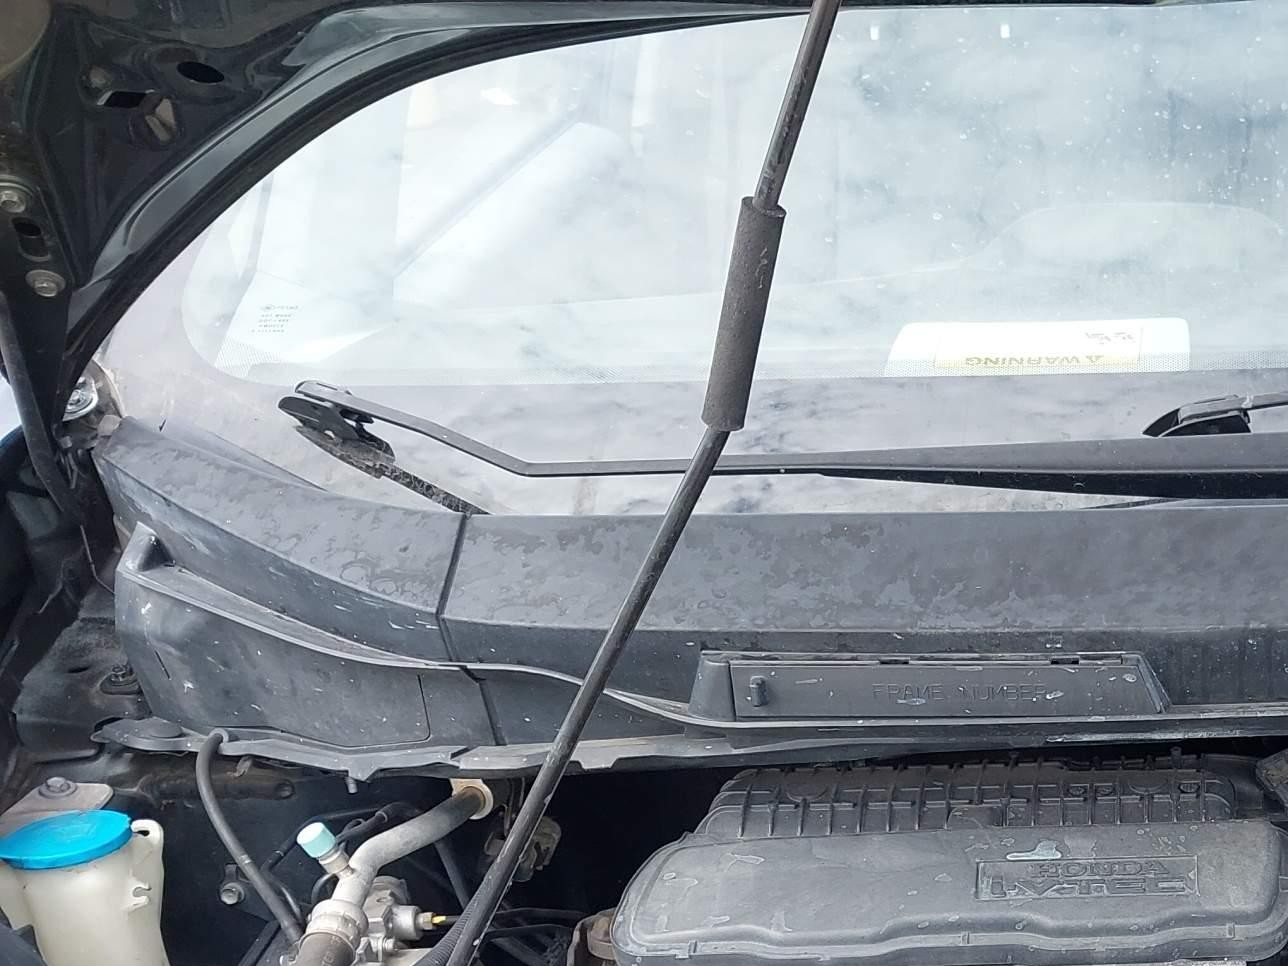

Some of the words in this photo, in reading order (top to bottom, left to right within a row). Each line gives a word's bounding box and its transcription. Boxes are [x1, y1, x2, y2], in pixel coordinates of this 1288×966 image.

[965, 356, 1081, 366] WARNING
[871, 683, 945, 701] FRAME
[1031, 860, 1169, 877] HONDA
